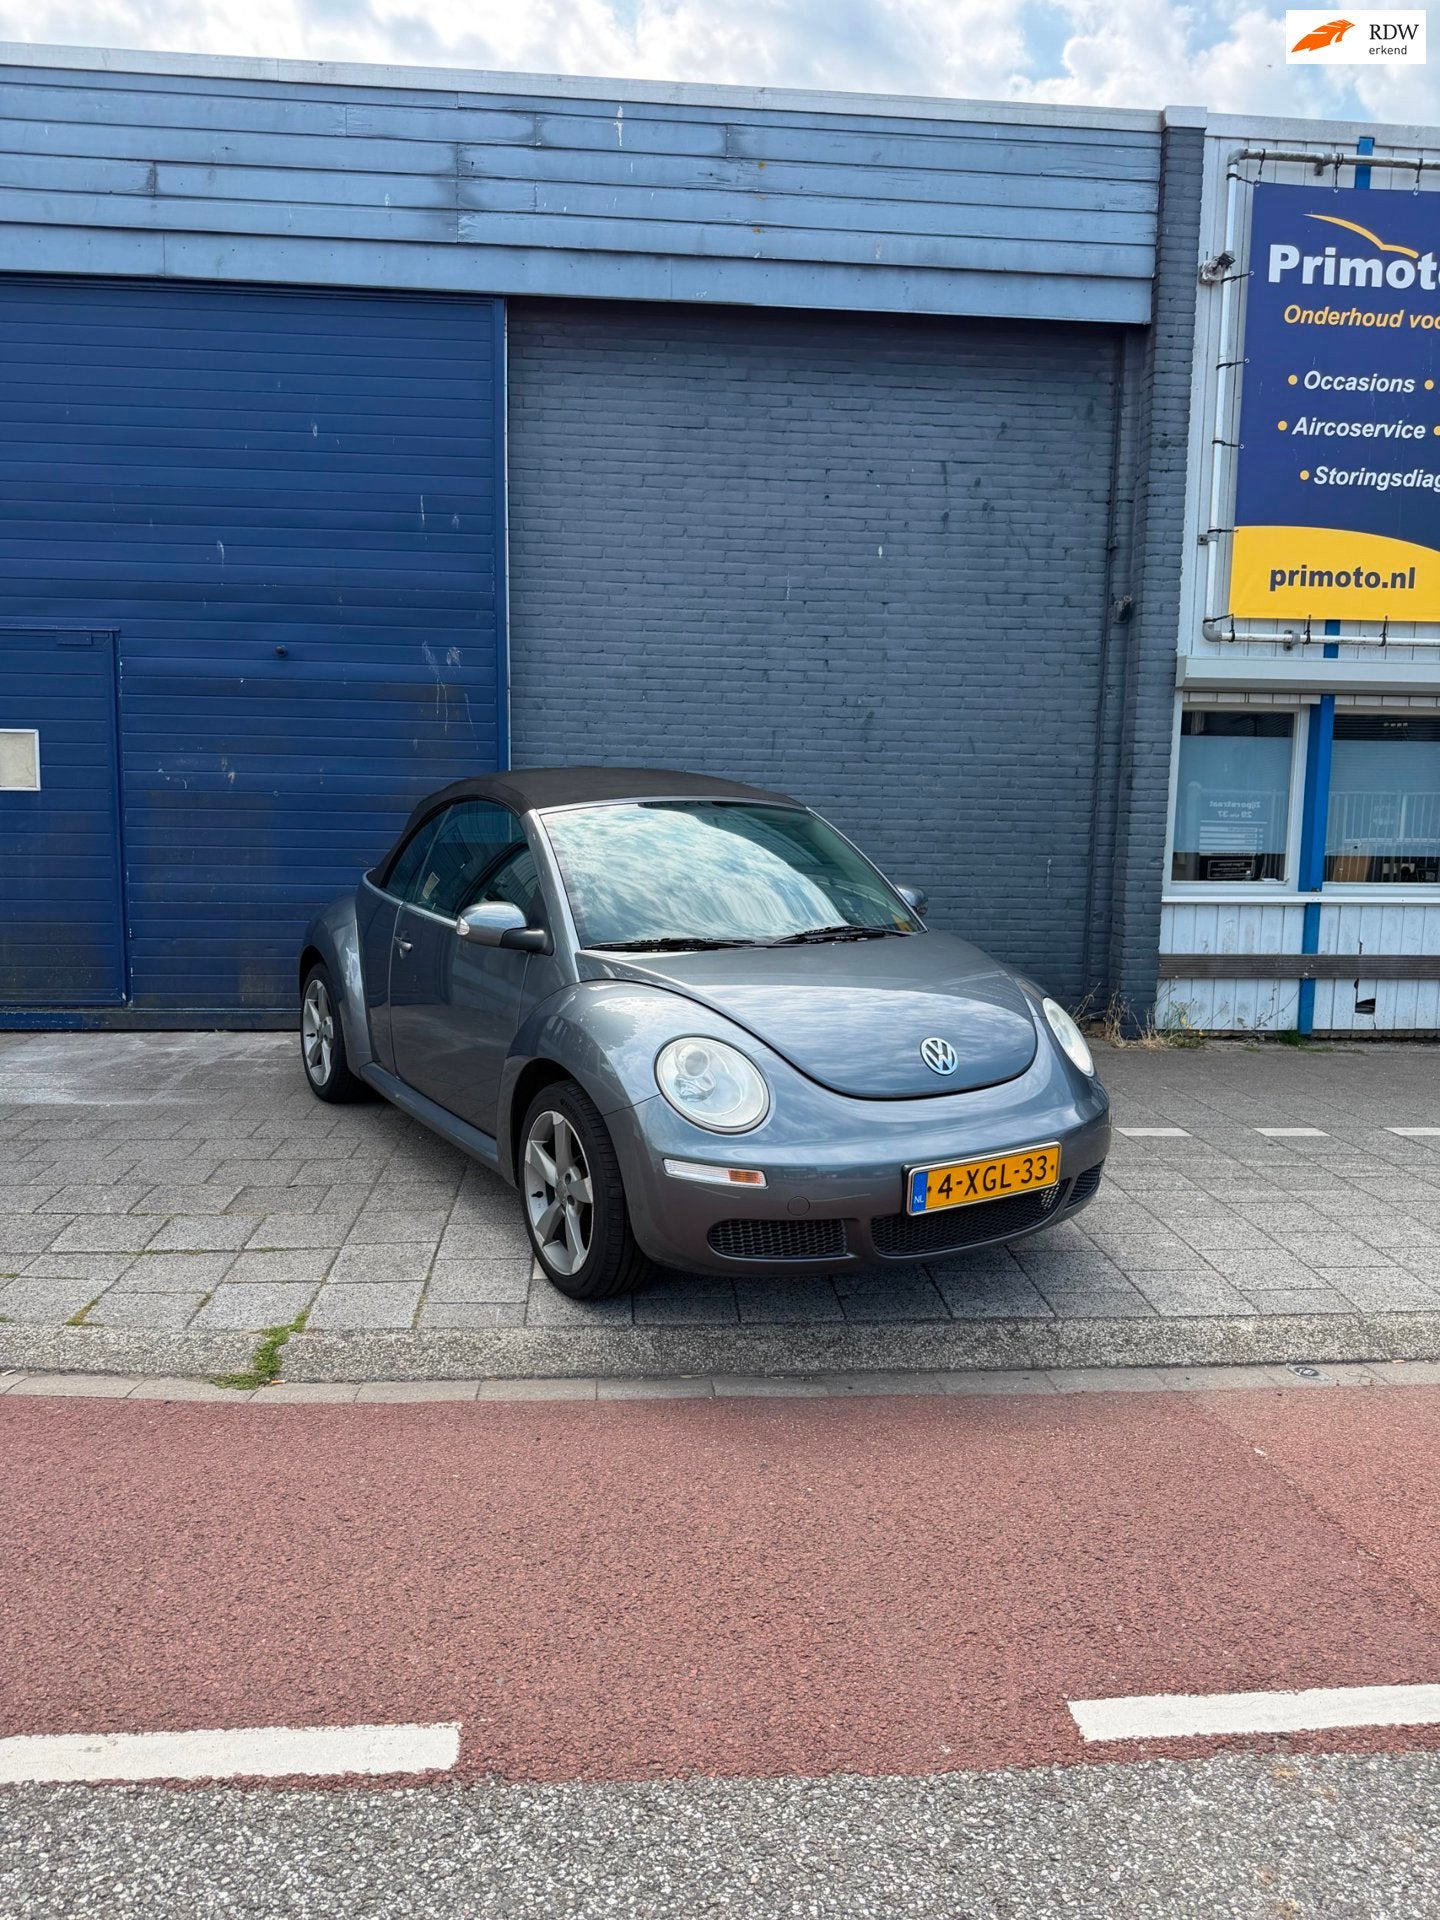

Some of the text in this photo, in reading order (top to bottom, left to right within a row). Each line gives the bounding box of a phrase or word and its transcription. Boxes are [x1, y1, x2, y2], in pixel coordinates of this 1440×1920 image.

[1268, 244, 1440, 291] Primot
[1284, 304, 1404, 328] Onderhoud
[1304, 370, 1416, 394] Occasions
[1291, 416, 1426, 440] Aircoservice
[1269, 565, 1416, 592] primoto.nl
[938, 1155, 1048, 1199] 4-XGL-33
[913, 1195, 924, 1203] NL
